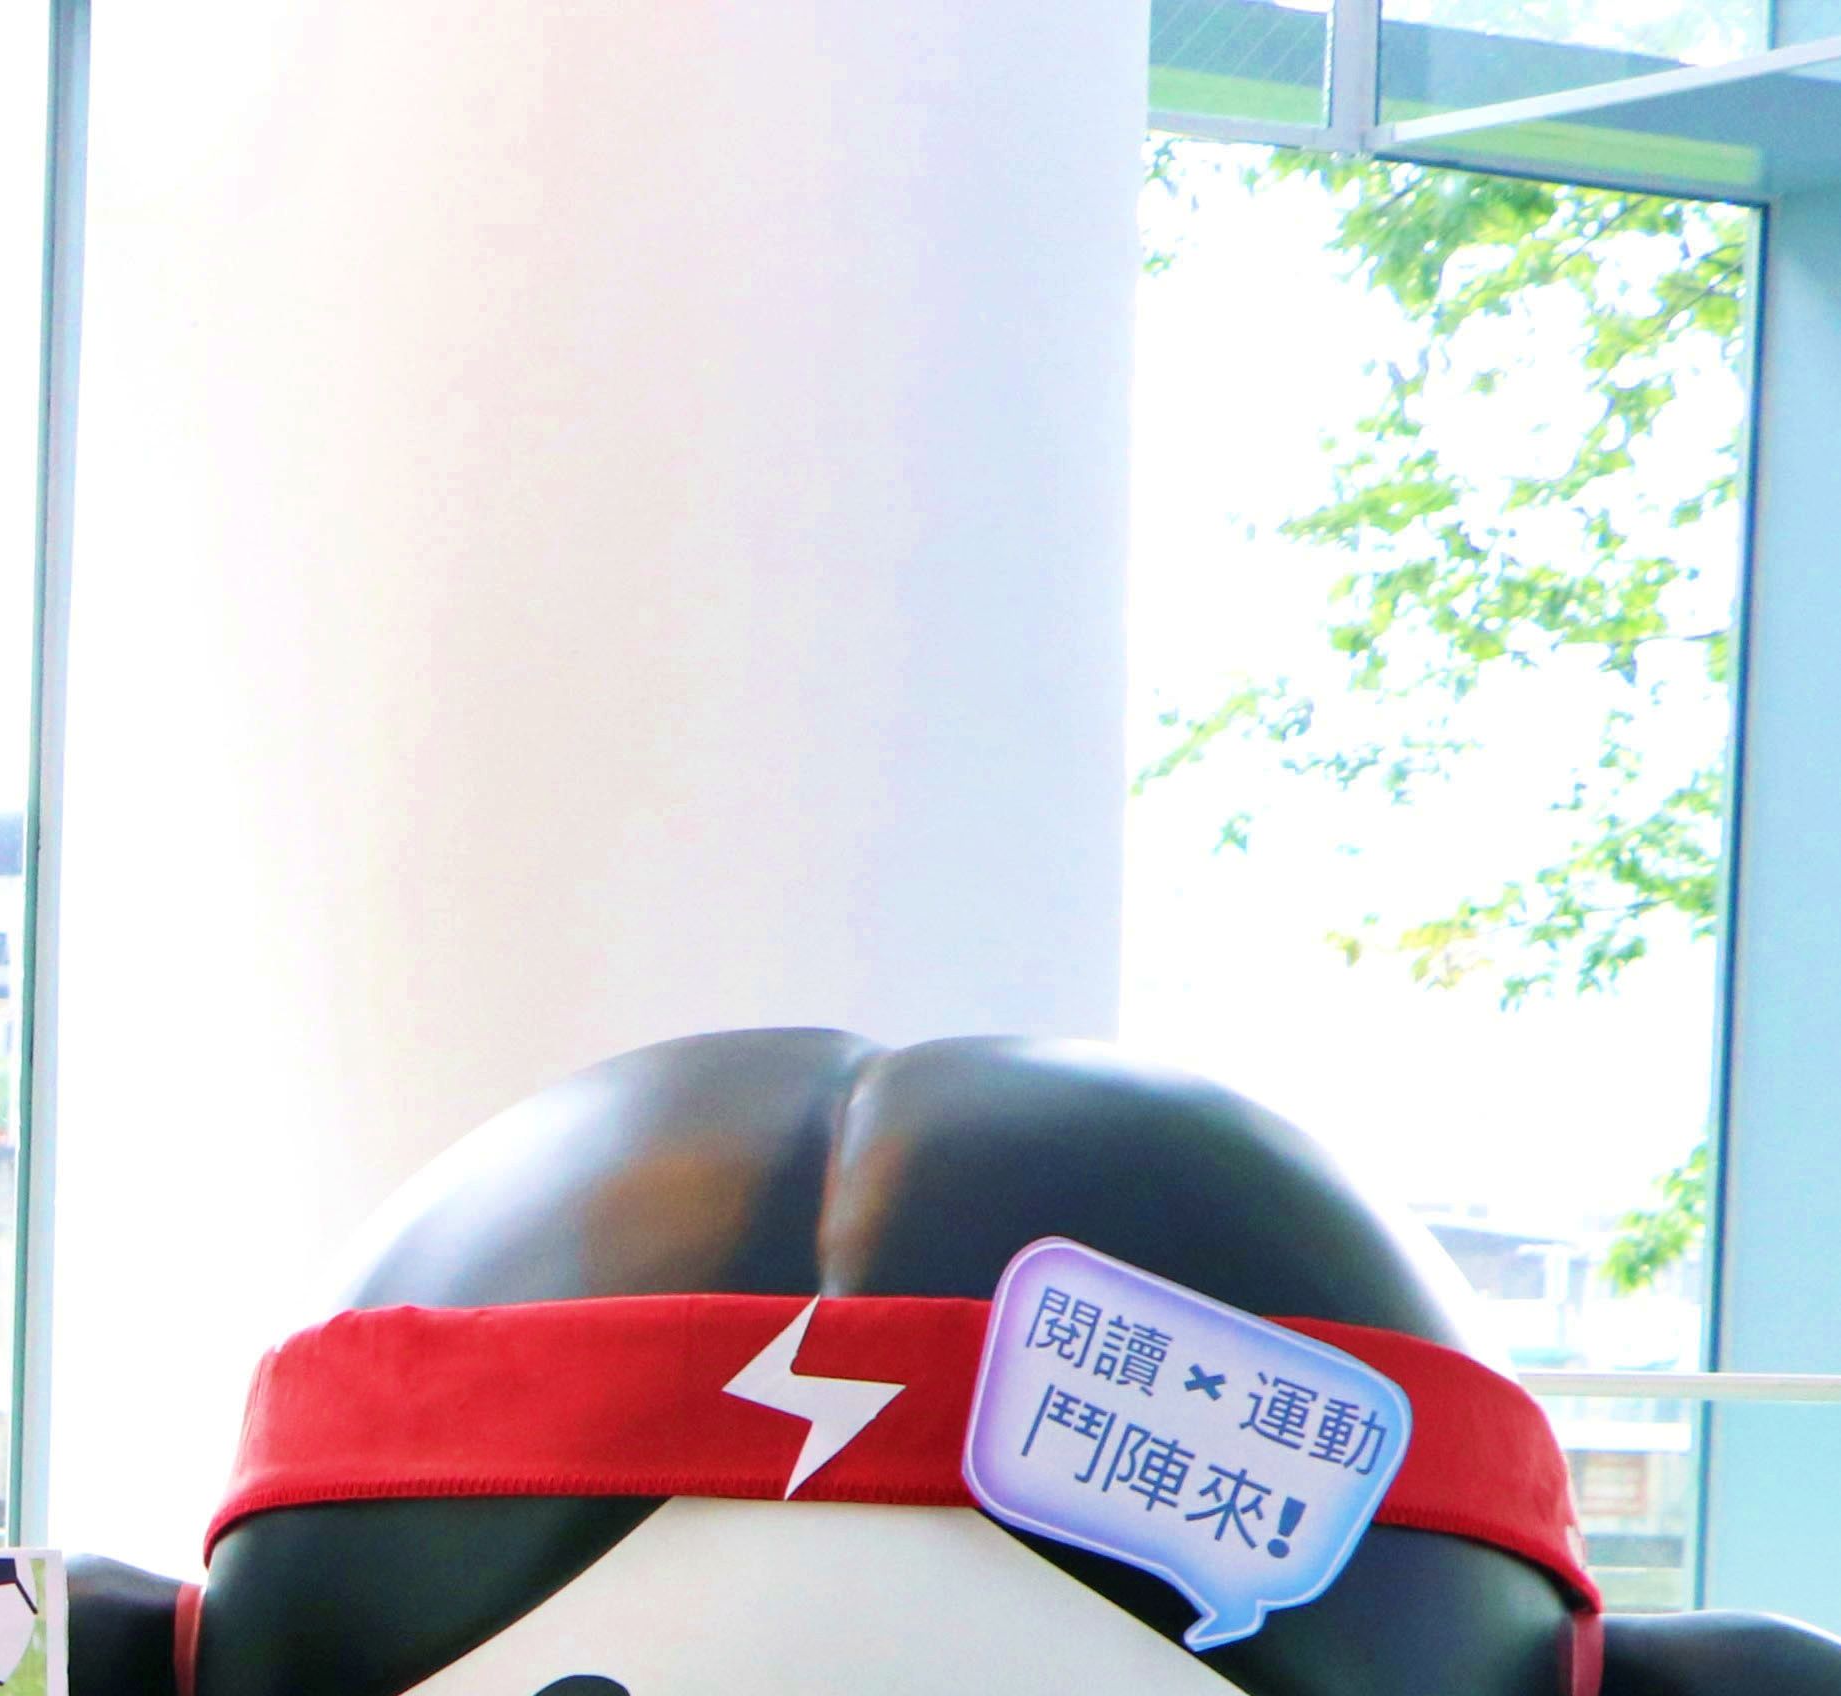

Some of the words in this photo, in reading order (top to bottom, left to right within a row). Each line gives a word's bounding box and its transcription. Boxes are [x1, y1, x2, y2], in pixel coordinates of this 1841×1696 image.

[1021, 1384, 1307, 1559] 鬥陣來!
[1025, 1286, 1173, 1397] 閱讀
[1239, 1371, 1388, 1476] 運動
